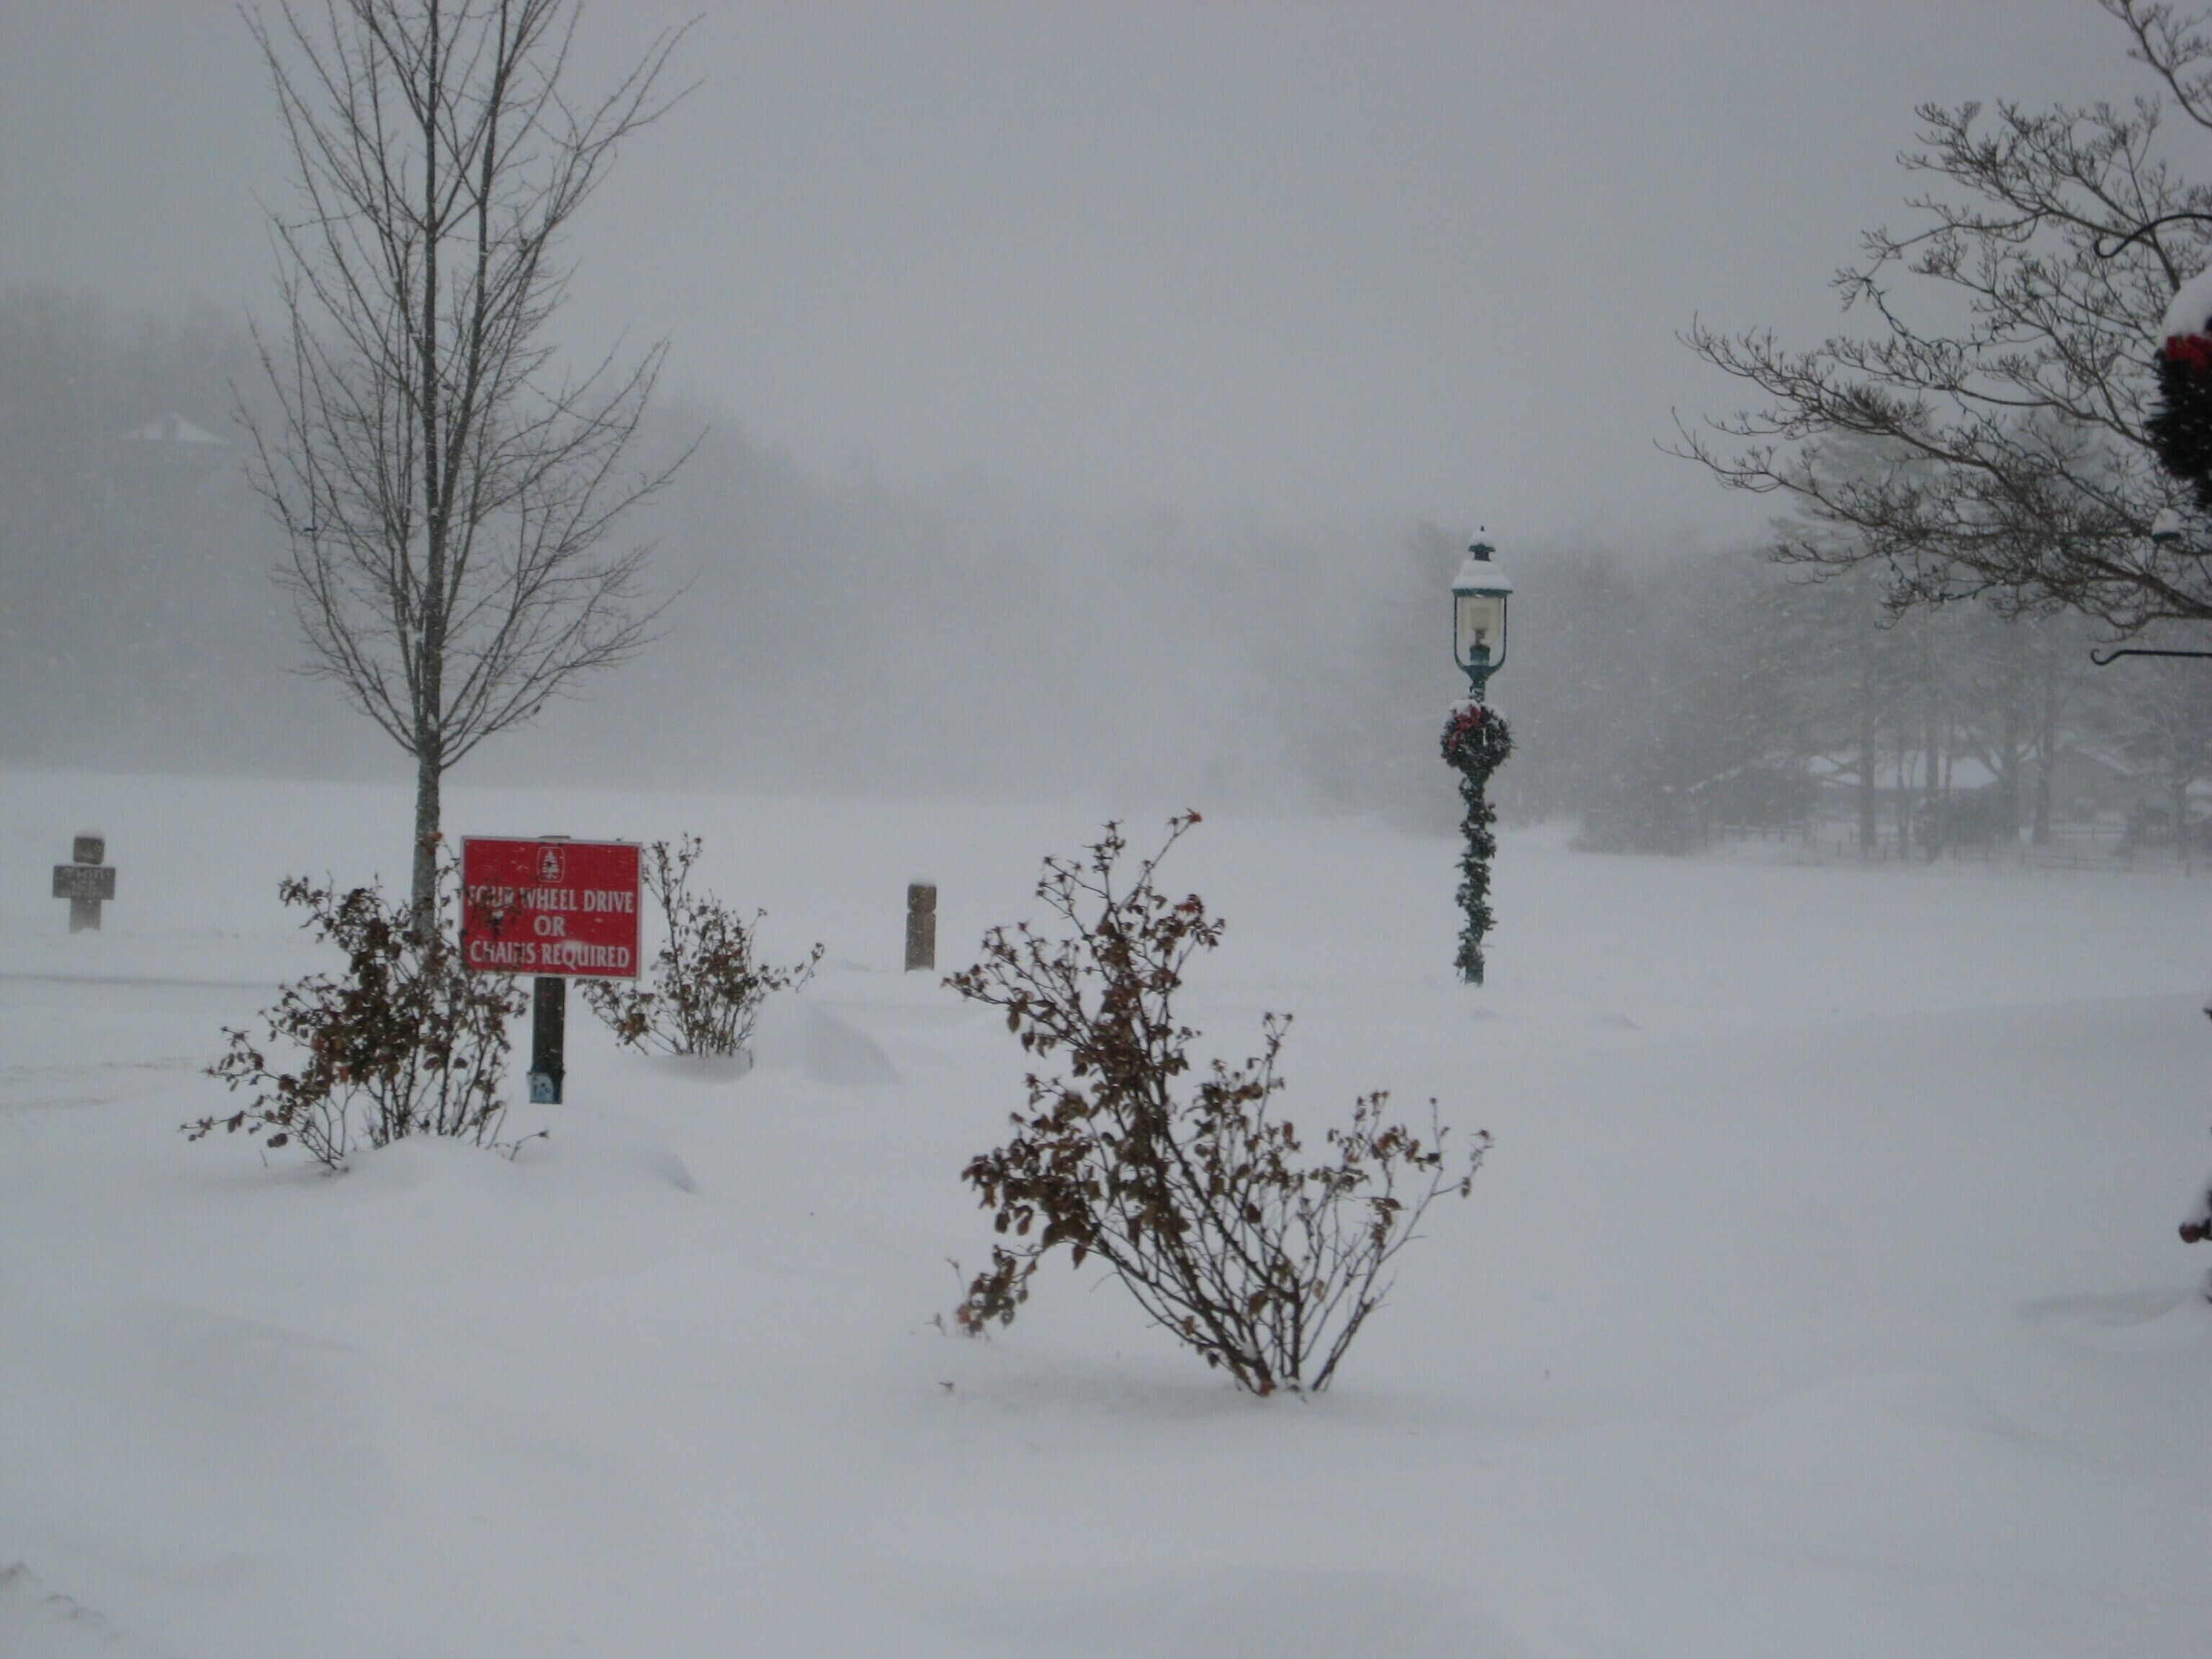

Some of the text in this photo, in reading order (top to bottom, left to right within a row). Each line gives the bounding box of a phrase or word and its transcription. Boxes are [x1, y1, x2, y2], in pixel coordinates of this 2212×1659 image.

[520, 887, 577, 910] WHEEL
[583, 889, 634, 913] DRIVE
[534, 915, 566, 937] OR
[541, 943, 629, 969] REQUIRED
